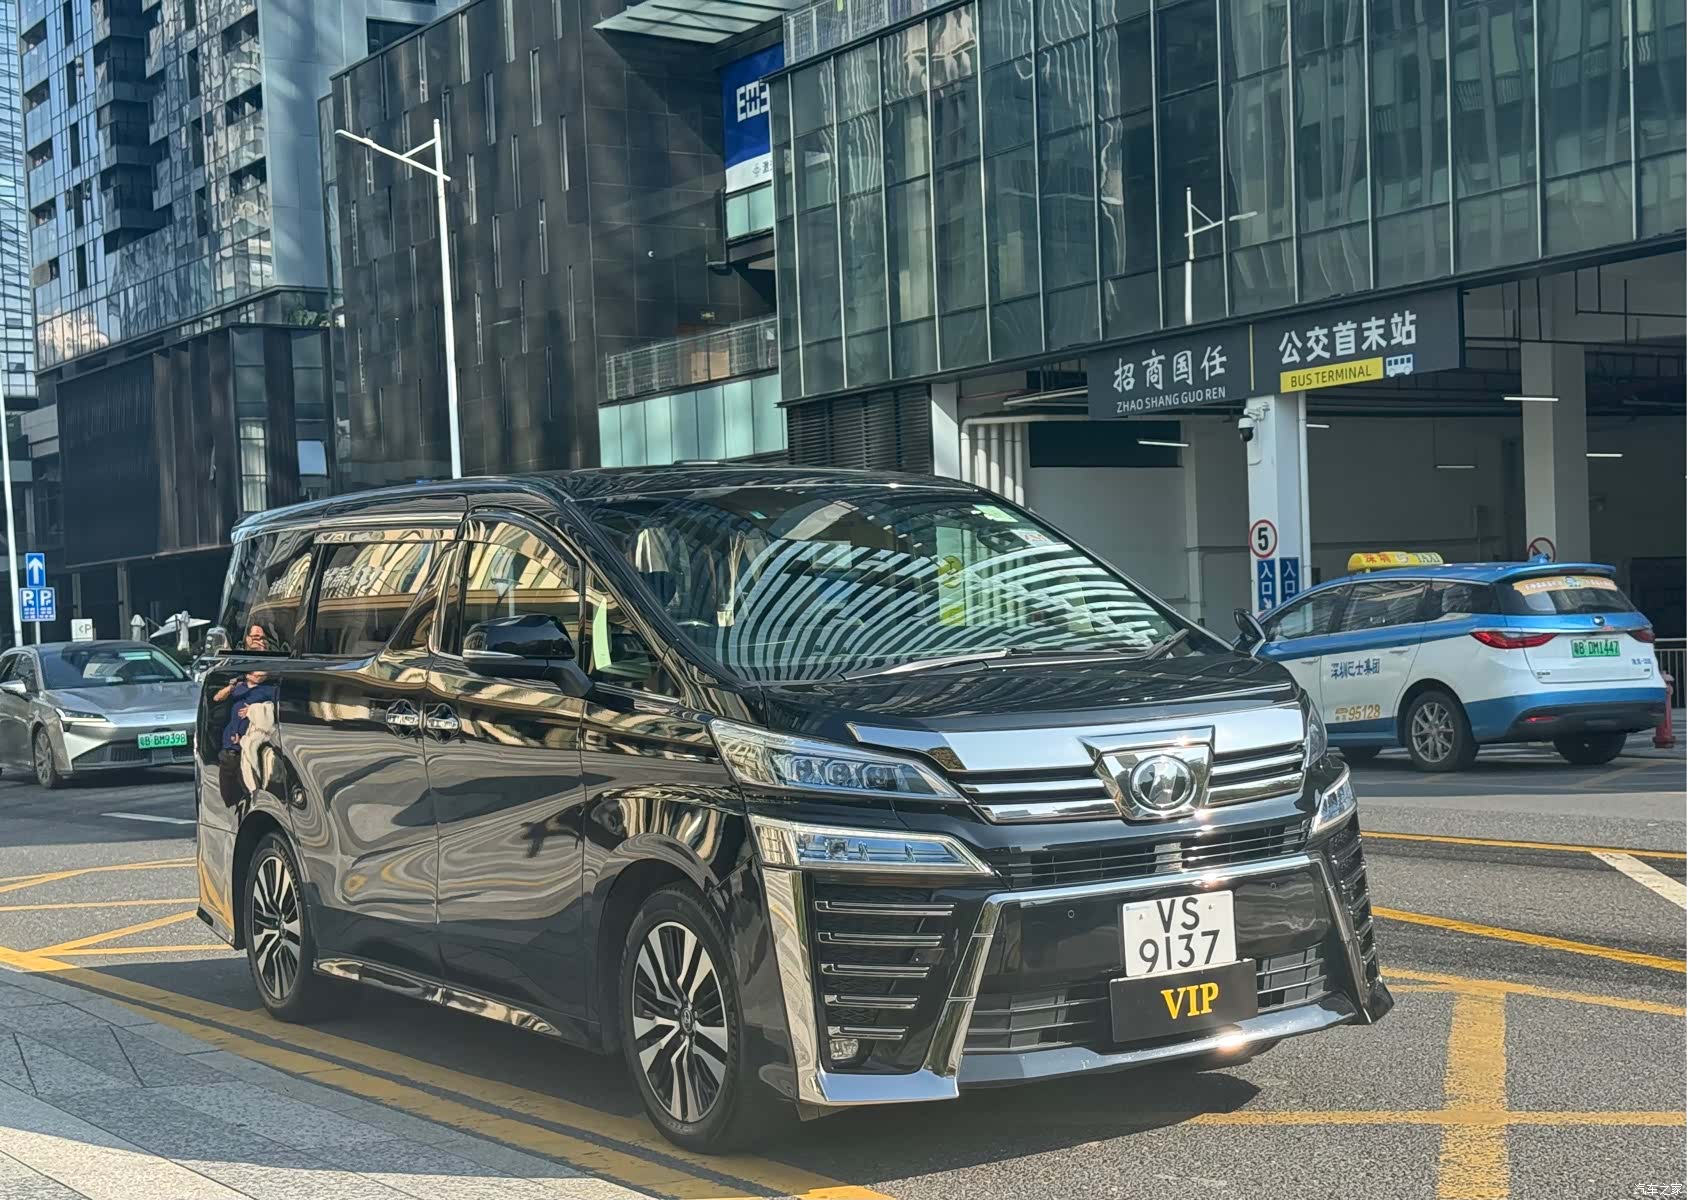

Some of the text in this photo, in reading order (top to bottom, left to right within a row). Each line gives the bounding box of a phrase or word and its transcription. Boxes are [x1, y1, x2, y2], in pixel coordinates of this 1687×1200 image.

[1278, 310, 1417, 365] 公交首末站
[1112, 345, 1228, 393] 招商国任
[1290, 364, 1372, 388] BUS TERMINAL
[1116, 386, 1226, 413] ZHAO SHANG GUO REN
[1257, 527, 1269, 551] 5
[1415, 552, 1441, 564] TAXI
[1260, 561, 1273, 595] 入口
[1283, 560, 1297, 594] 入口
[22, 590, 35, 607] P
[40, 589, 52, 606] P
[1348, 704, 1381, 721] 95128
[1156, 896, 1200, 933] VS
[1138, 929, 1221, 974] 9137
[1160, 982, 1220, 1020] VIP
